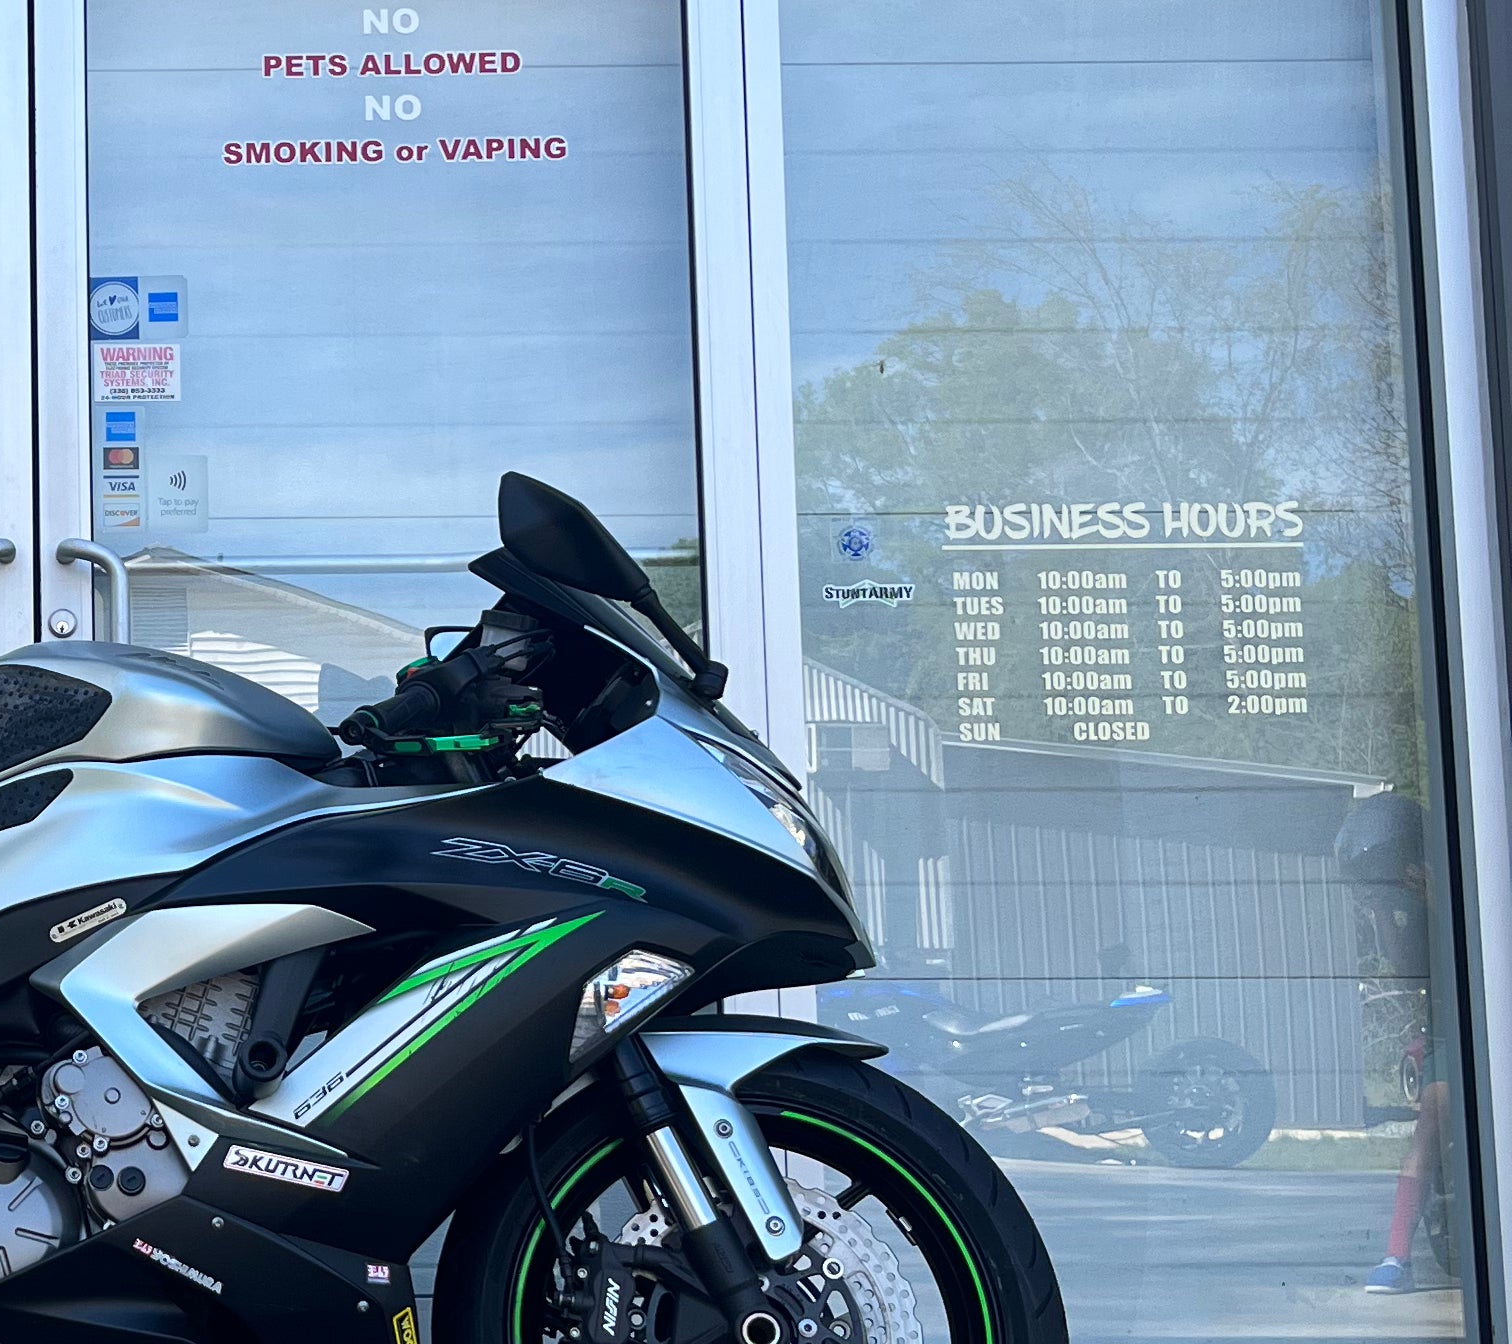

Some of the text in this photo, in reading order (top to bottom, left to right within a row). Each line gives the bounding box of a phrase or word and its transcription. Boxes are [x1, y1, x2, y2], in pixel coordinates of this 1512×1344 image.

[362, 8, 419, 34] NO
[262, 50, 522, 78] PETS ALLOWED
[364, 94, 422, 120] NO
[223, 136, 568, 165] SMOKING or VAPING
[100, 347, 174, 361] WARNING
[100, 370, 174, 378] TRIAD SECURITY
[152, 378, 170, 386] INC.
[109, 482, 136, 491] VISA
[159, 498, 172, 506] Tap
[185, 499, 199, 507] pay
[161, 508, 196, 516] preferred
[944, 501, 1303, 540] BUSINESS HOURS
[952, 569, 1301, 590] MON 10:00am TO 5:00pm
[953, 595, 1301, 615] TUES 10:00am TO 5:00pm
[954, 620, 1303, 640] WED 10:00am TO 5:00pm
[955, 645, 1304, 666] THU 10:00am TO 5:00pm
[957, 670, 1307, 691] FRI 10:00am TO 5:00pm
[958, 695, 1308, 716] SAT 10:00am TO 2:00pm
[959, 721, 1150, 741] SUN CLOSED
[77, 901, 117, 926] Kawasaki
[293, 1071, 344, 1120] 636
